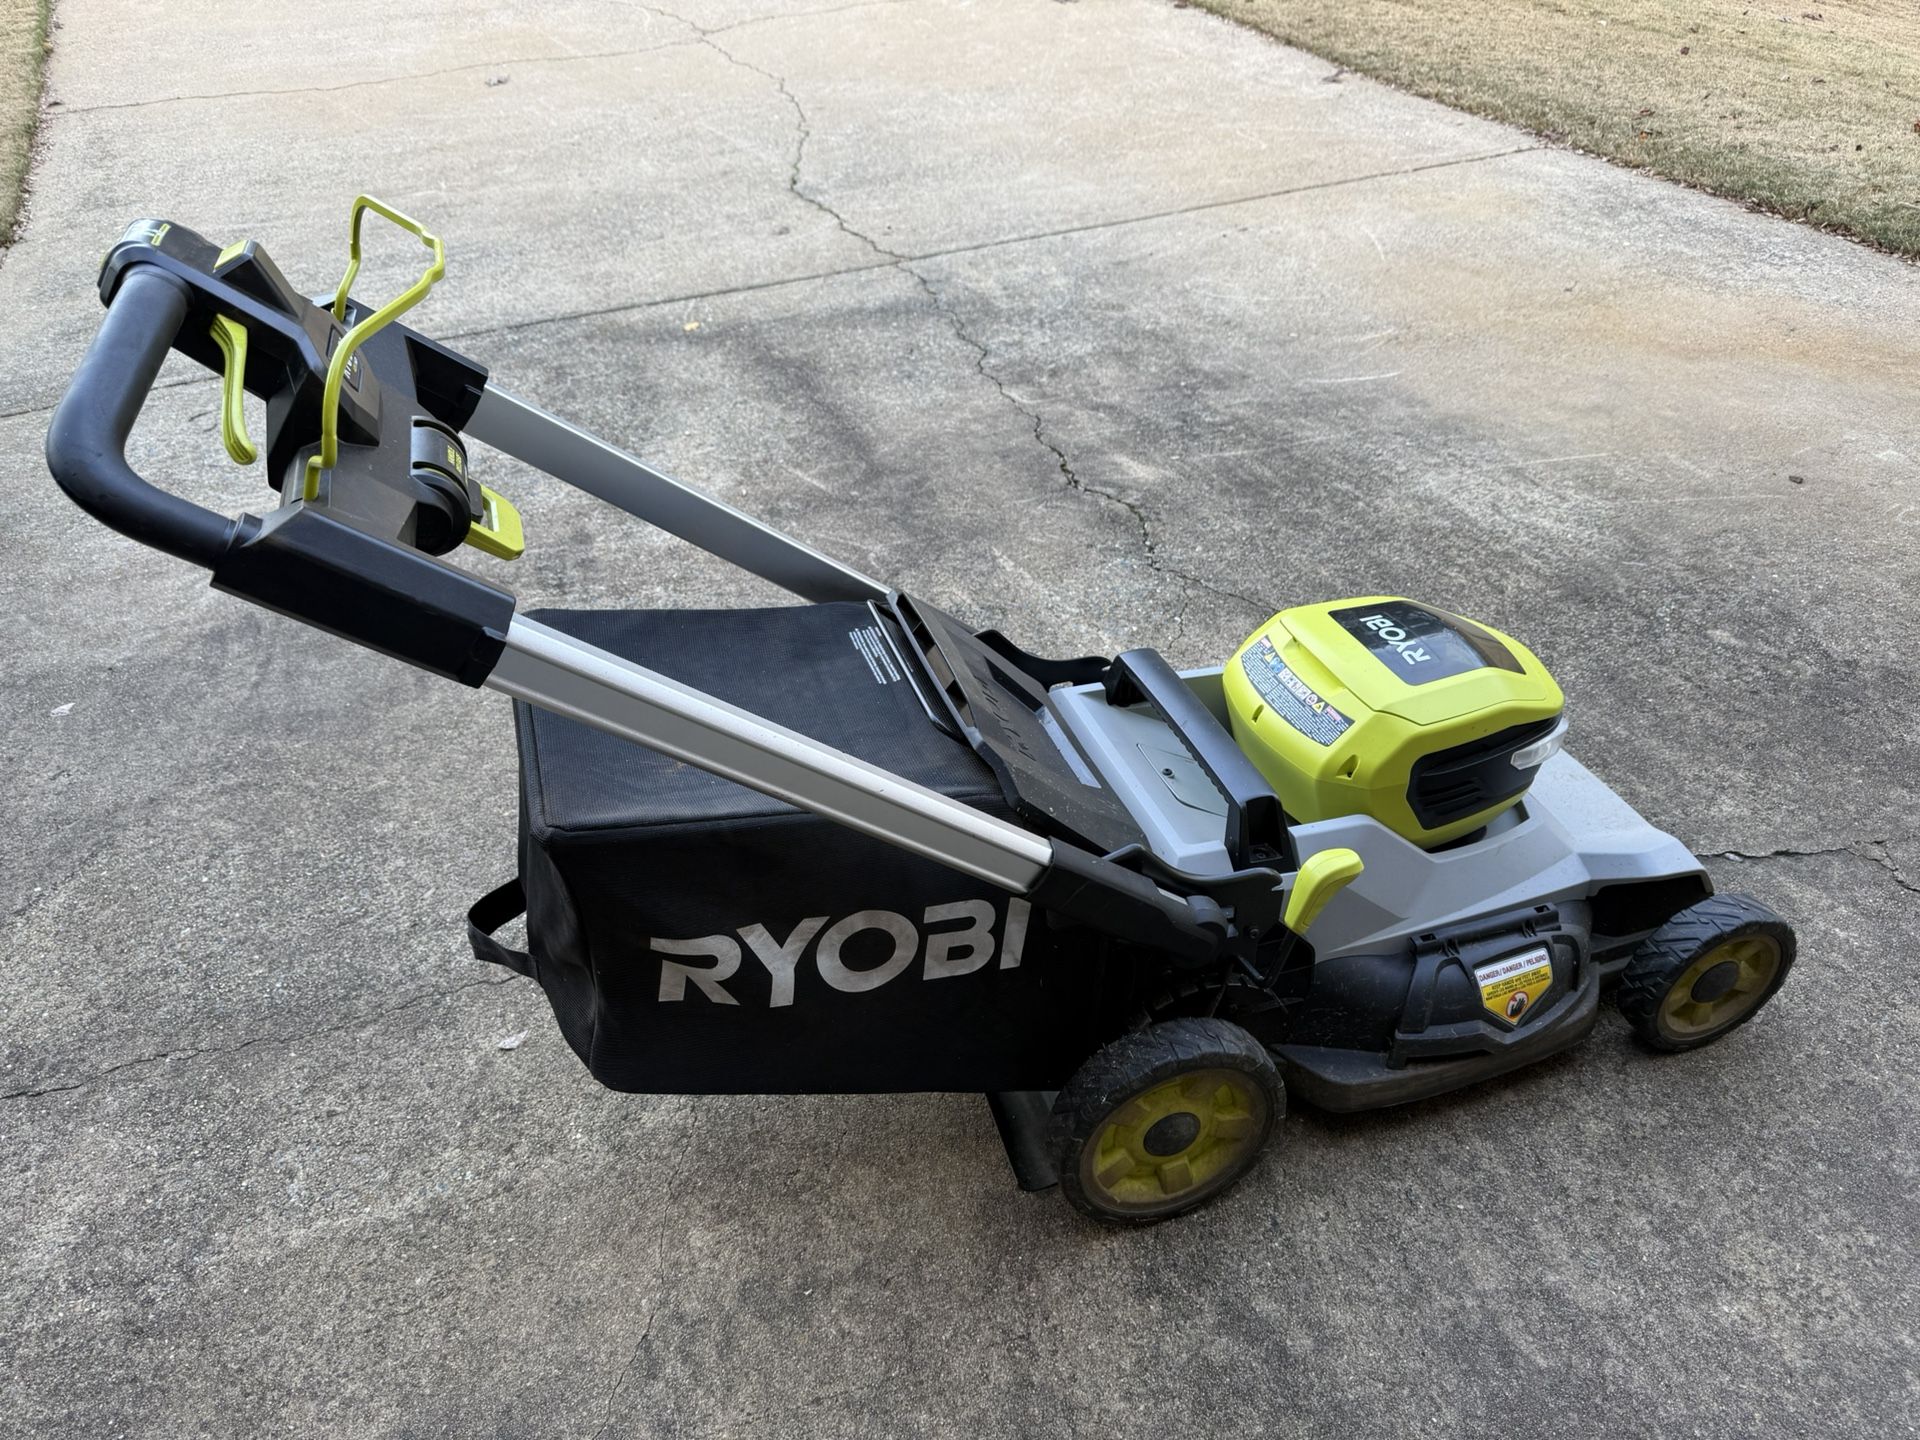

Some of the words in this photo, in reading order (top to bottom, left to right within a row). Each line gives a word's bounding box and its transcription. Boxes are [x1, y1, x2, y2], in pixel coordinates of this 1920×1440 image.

[1359, 614, 1432, 665] RYOBI
[650, 897, 1032, 1008] RYOBI
[1479, 970, 1500, 982] DANGER
[1502, 962, 1523, 974] DANGER
[1526, 954, 1546, 966] PELIGRO
